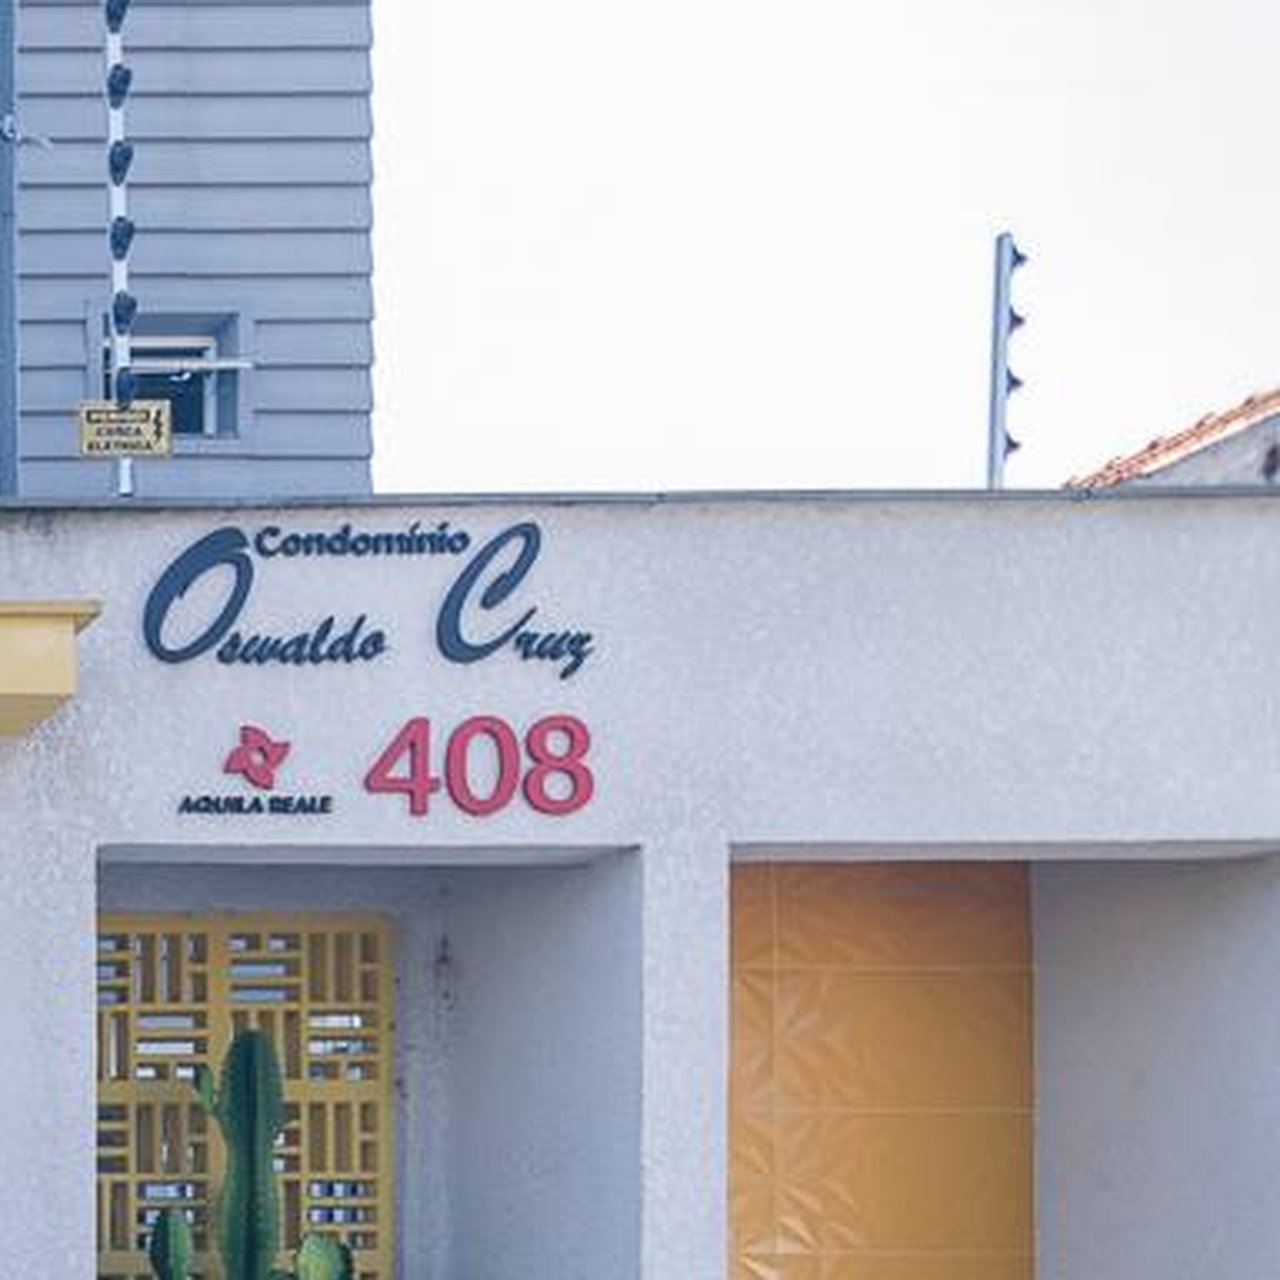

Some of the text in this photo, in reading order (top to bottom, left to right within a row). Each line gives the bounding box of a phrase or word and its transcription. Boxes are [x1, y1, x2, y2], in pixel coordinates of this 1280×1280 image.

[143, 521, 596, 680] Oswaldo Cruz
[267, 794, 334, 815] REALE
[363, 714, 595, 818] 408
